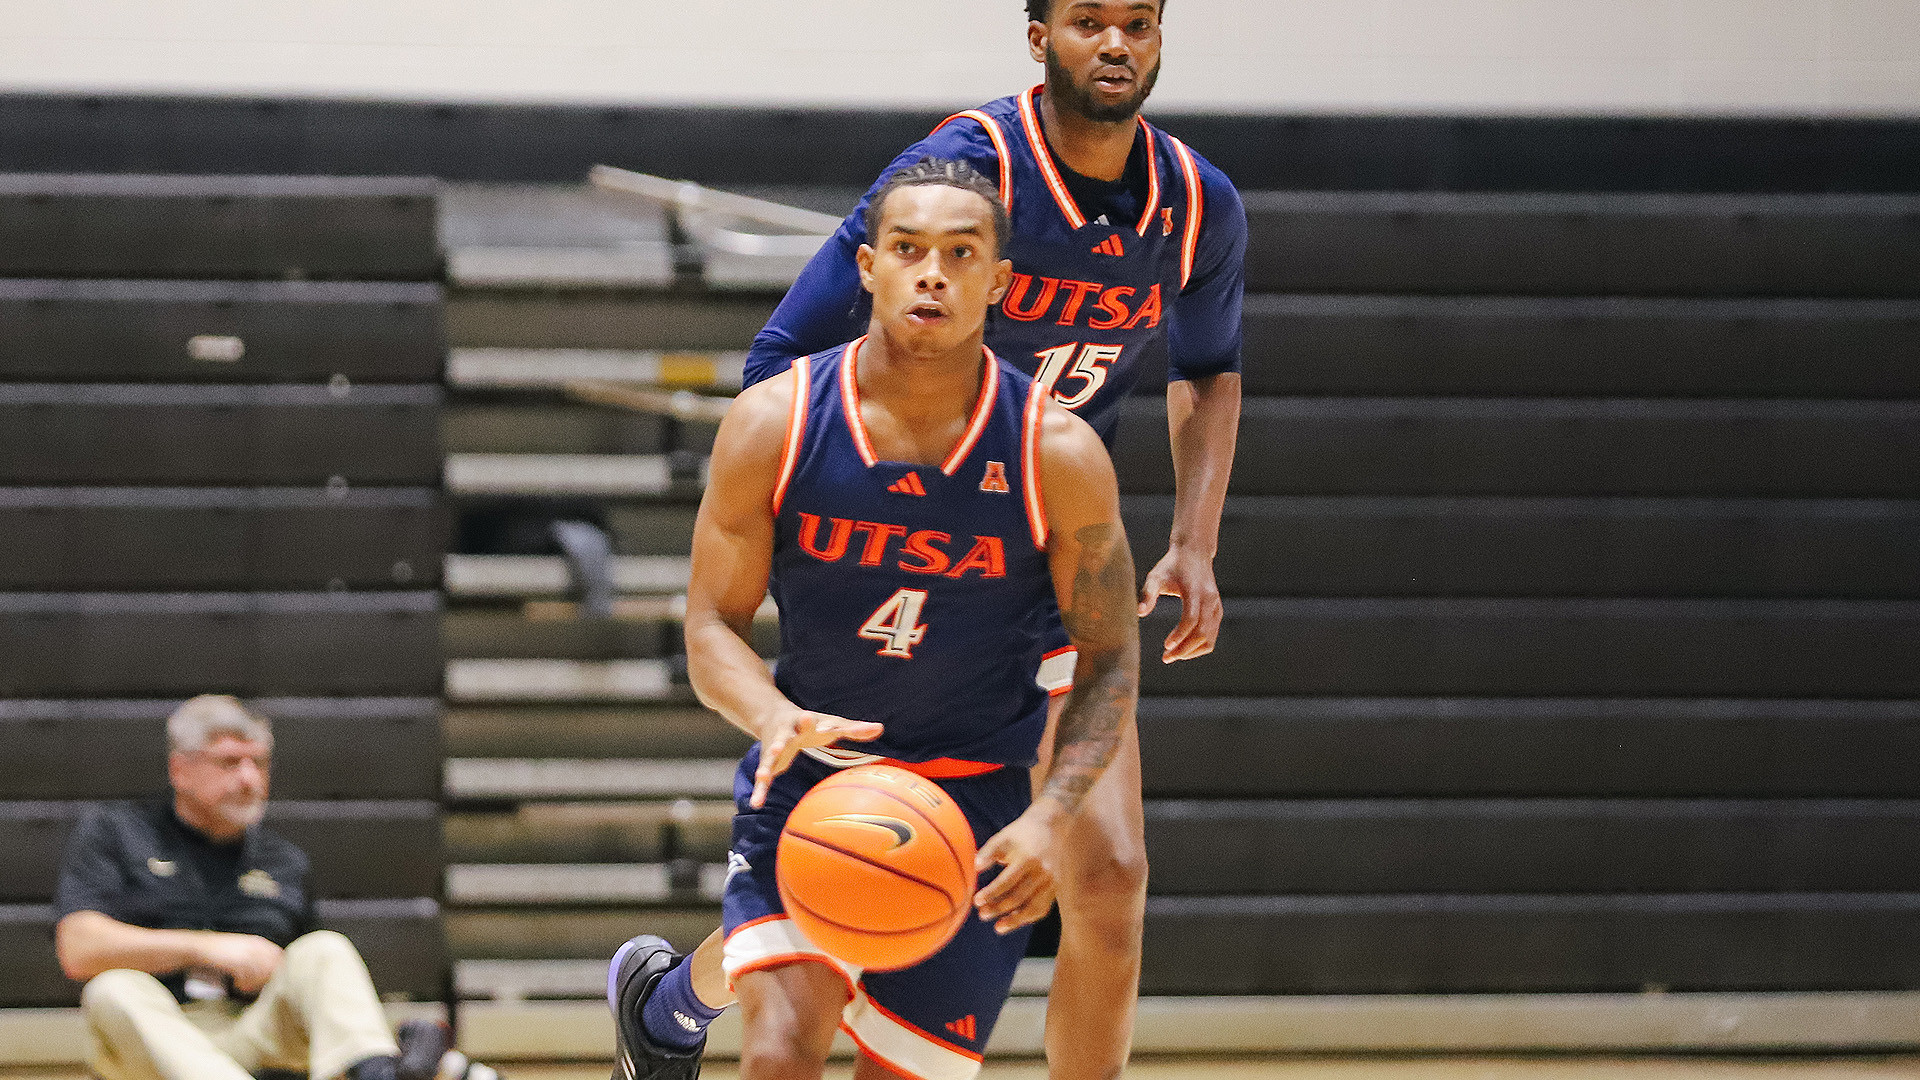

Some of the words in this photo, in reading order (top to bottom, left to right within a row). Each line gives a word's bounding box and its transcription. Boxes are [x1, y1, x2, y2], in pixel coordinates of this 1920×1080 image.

[1002, 272, 1162, 330] UTSA
[1034, 341, 1124, 410] 15
[979, 461, 1010, 493] A
[798, 512, 1006, 578] UTSA
[857, 587, 928, 659] 4
